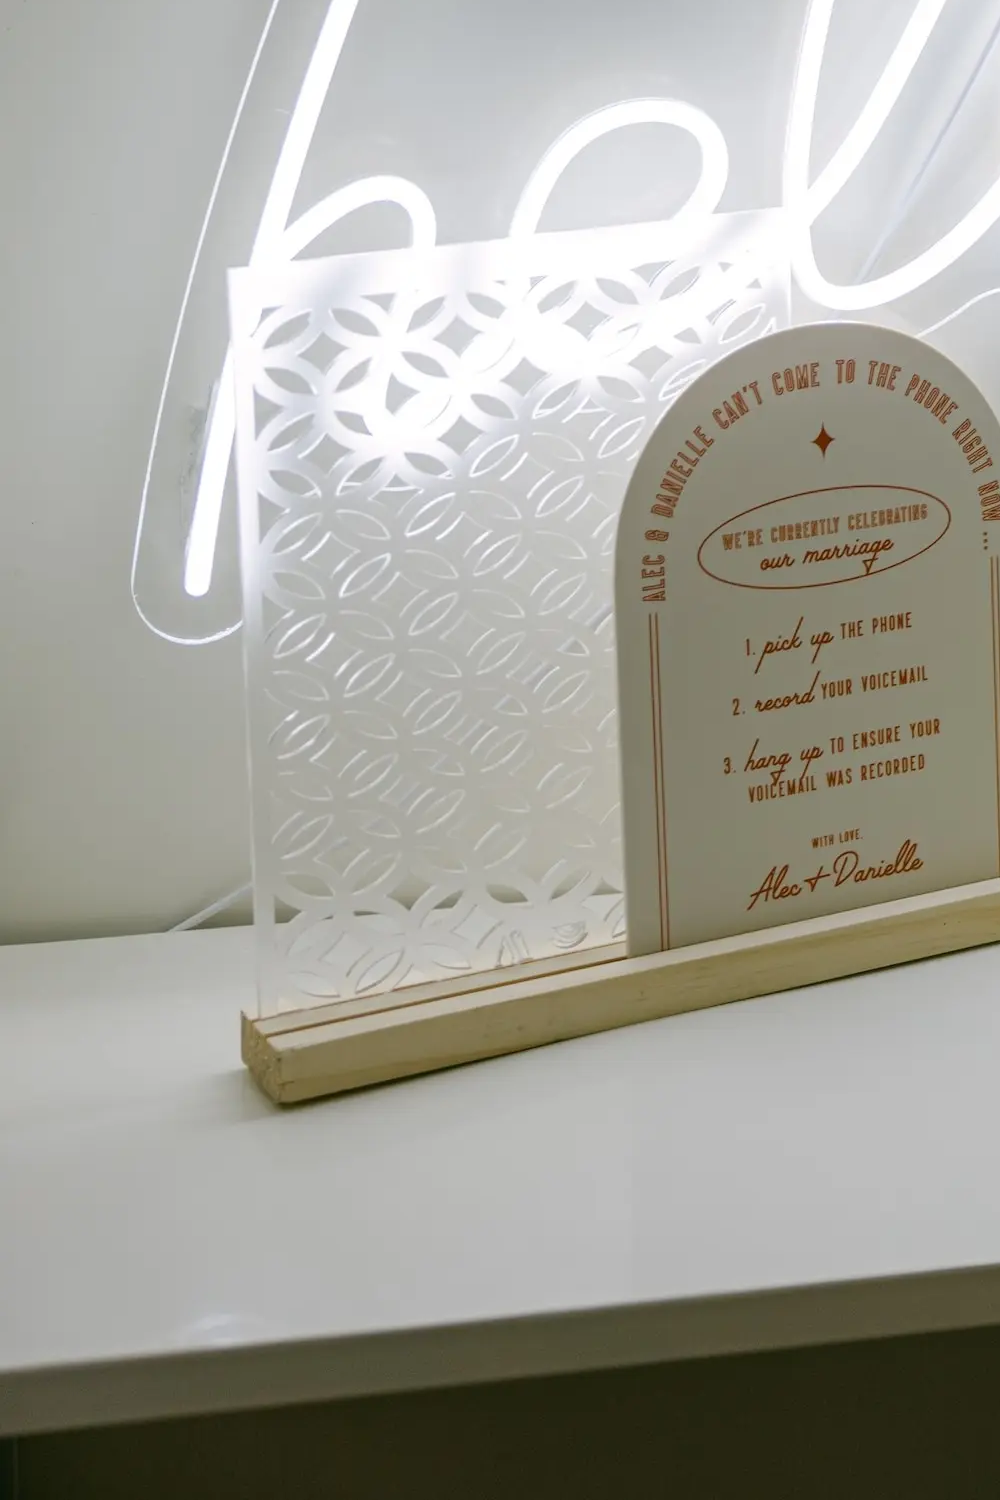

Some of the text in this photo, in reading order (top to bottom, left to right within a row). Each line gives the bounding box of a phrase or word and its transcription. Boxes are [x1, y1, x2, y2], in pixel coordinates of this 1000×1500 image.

[771, 362, 820, 396] COME
[835, 359, 856, 385] TO
[867, 360, 902, 392] THE
[711, 381, 763, 430] CAN'T
[904, 373, 960, 425] PHONE
[951, 418, 993, 474] RIGHT
[650, 425, 715, 519] DANIELLE
[644, 529, 669, 542] &
[721, 503, 929, 551] WE'RE CURRENTLY CELEBRATING
[642, 554, 666, 602] ALEC
[760, 538, 895, 576] our marriage
[745, 611, 913, 675] 1. pick up THE PHONE
[732, 665, 929, 716] 2. record YOUR VOICEMAIL
[723, 718, 941, 786] 3. hang up TO ENSURE YOUR
[748, 753, 925, 803] VOICEMAIL WAS RECORDED
[811, 834, 835, 849] WITH
[746, 864, 802, 911] Alec
[833, 838, 924, 887] Danielle
